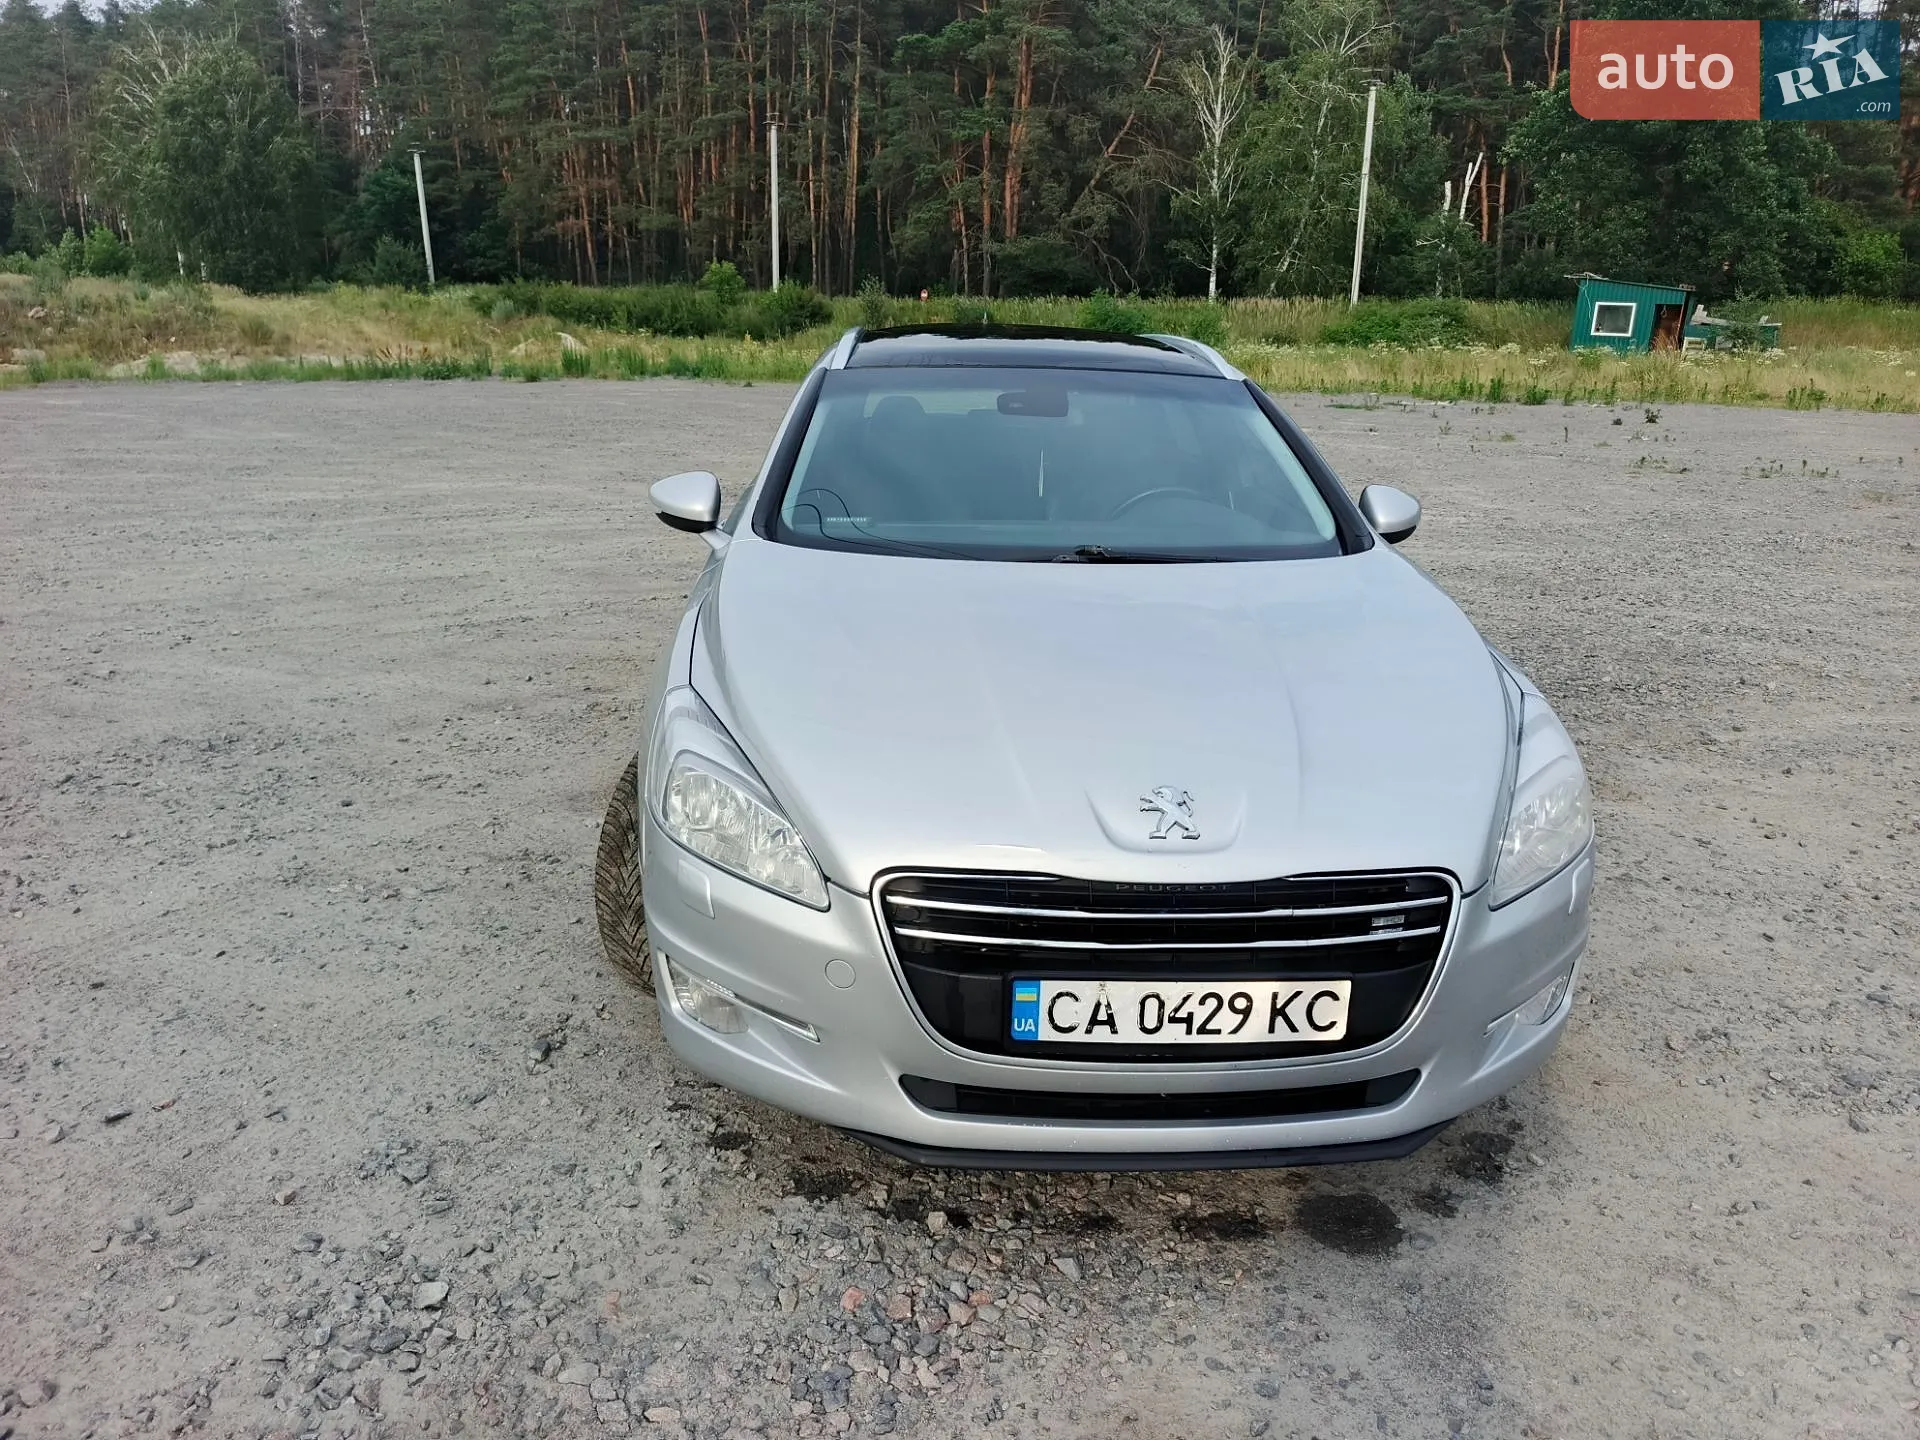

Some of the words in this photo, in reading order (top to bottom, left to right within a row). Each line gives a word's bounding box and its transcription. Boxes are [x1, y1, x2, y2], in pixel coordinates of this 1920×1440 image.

[1115, 883, 1231, 892] PEUGEOT
[1047, 989, 1119, 1035] CA
[1137, 990, 1254, 1036] 0429
[1267, 989, 1341, 1034] KC
[1013, 1018, 1036, 1033] UA
